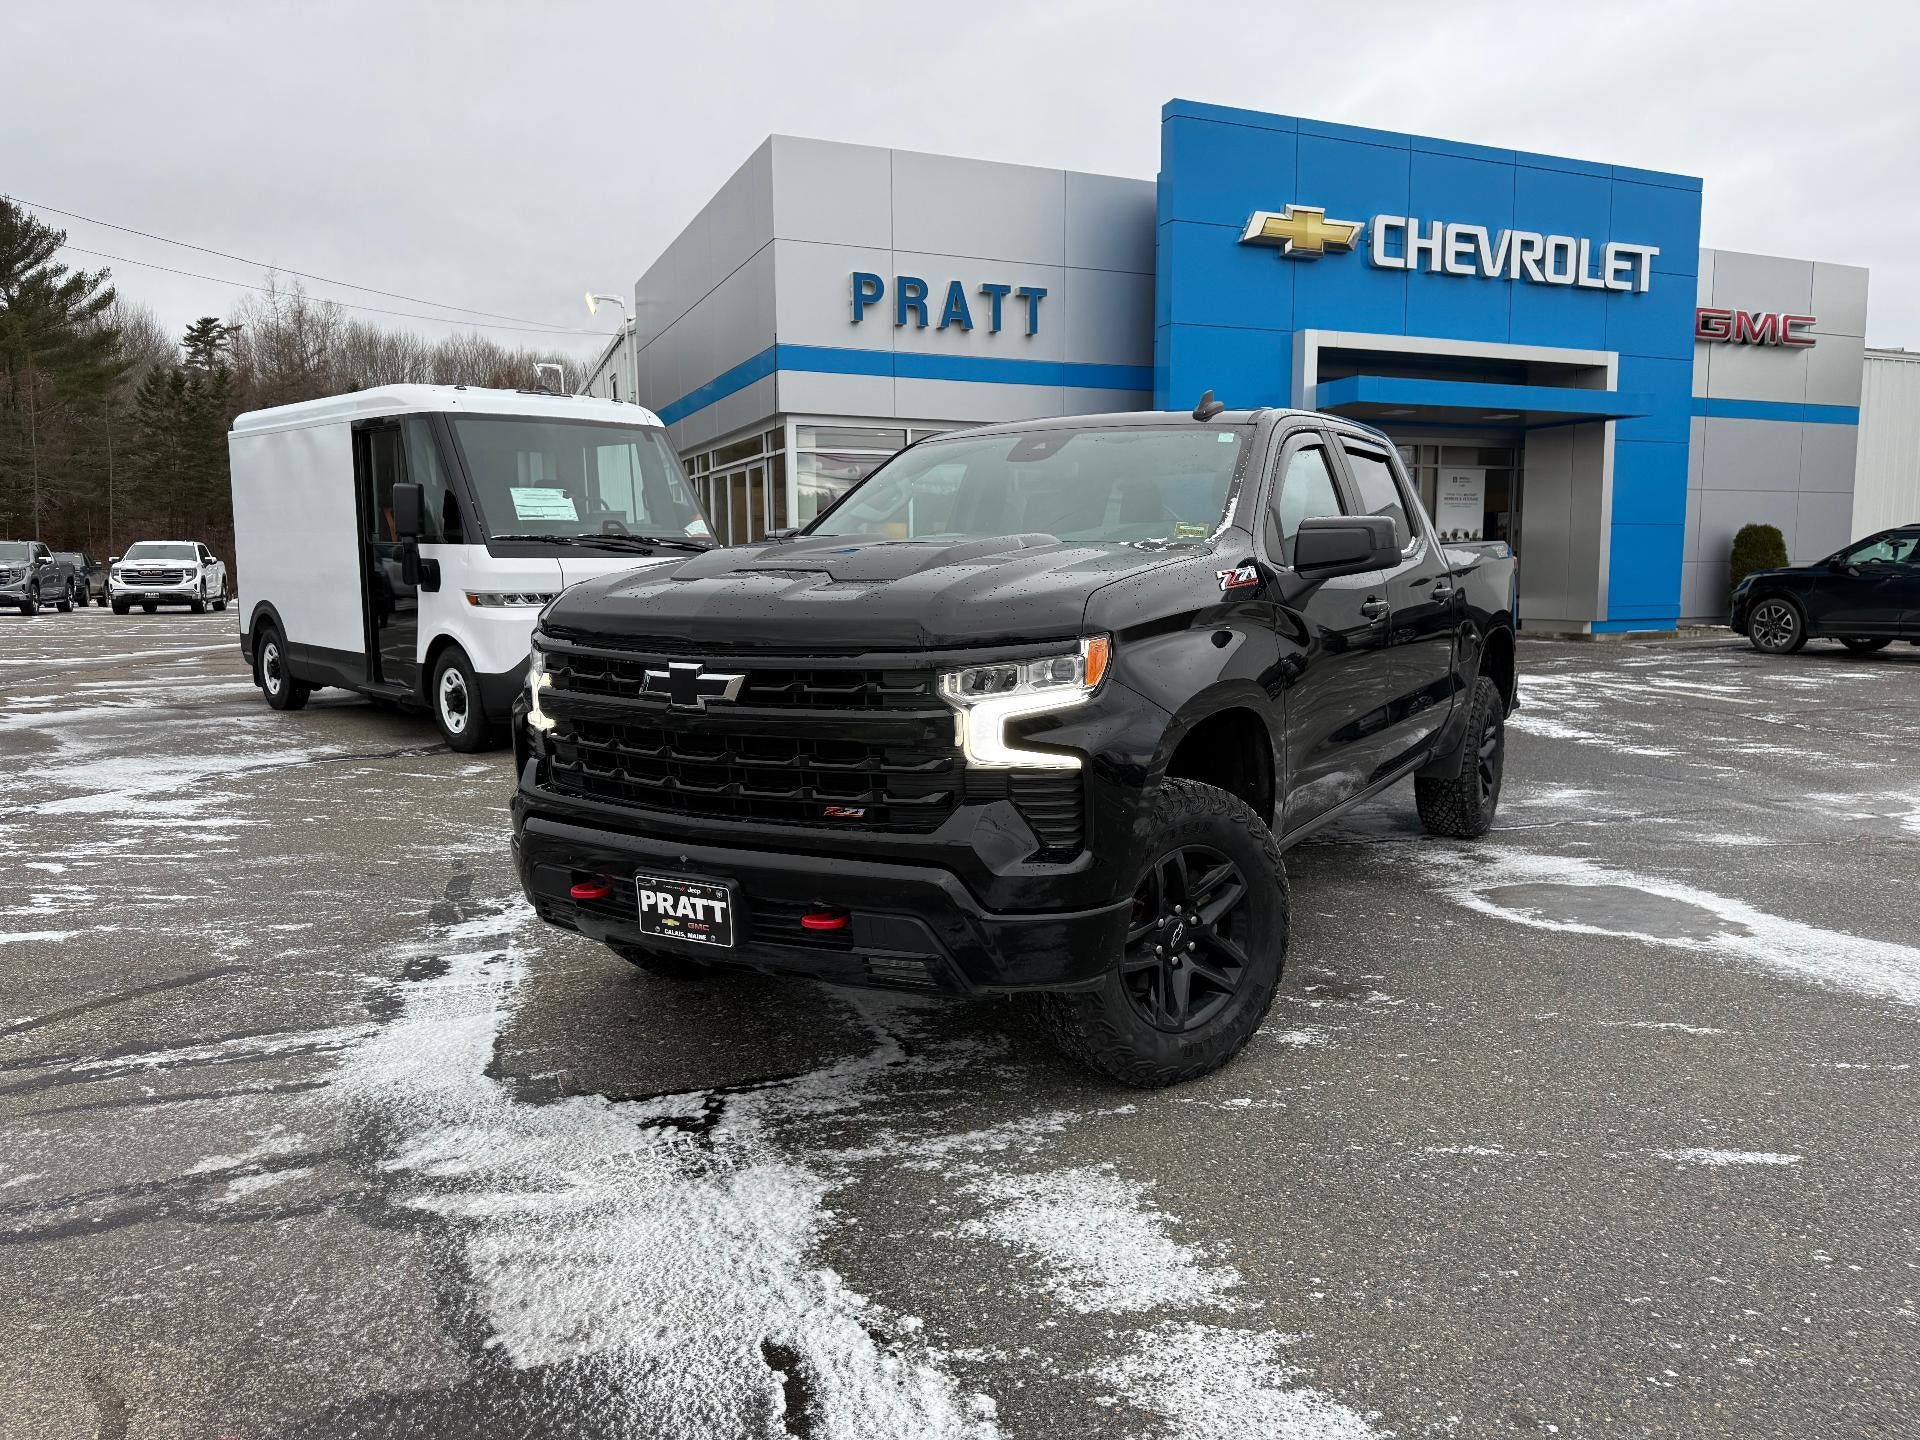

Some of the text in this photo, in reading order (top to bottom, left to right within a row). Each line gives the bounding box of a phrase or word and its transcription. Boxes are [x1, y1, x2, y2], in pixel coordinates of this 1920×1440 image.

[1369, 214, 1660, 293] CHEVROLET
[849, 271, 1048, 336] PRATT
[1695, 307, 1817, 348] GMC
[640, 889, 727, 923] PRATT
[687, 887, 701, 895] Jeep
[664, 928, 707, 940] CALAIS, MAINE
[687, 922, 710, 932] GMC
